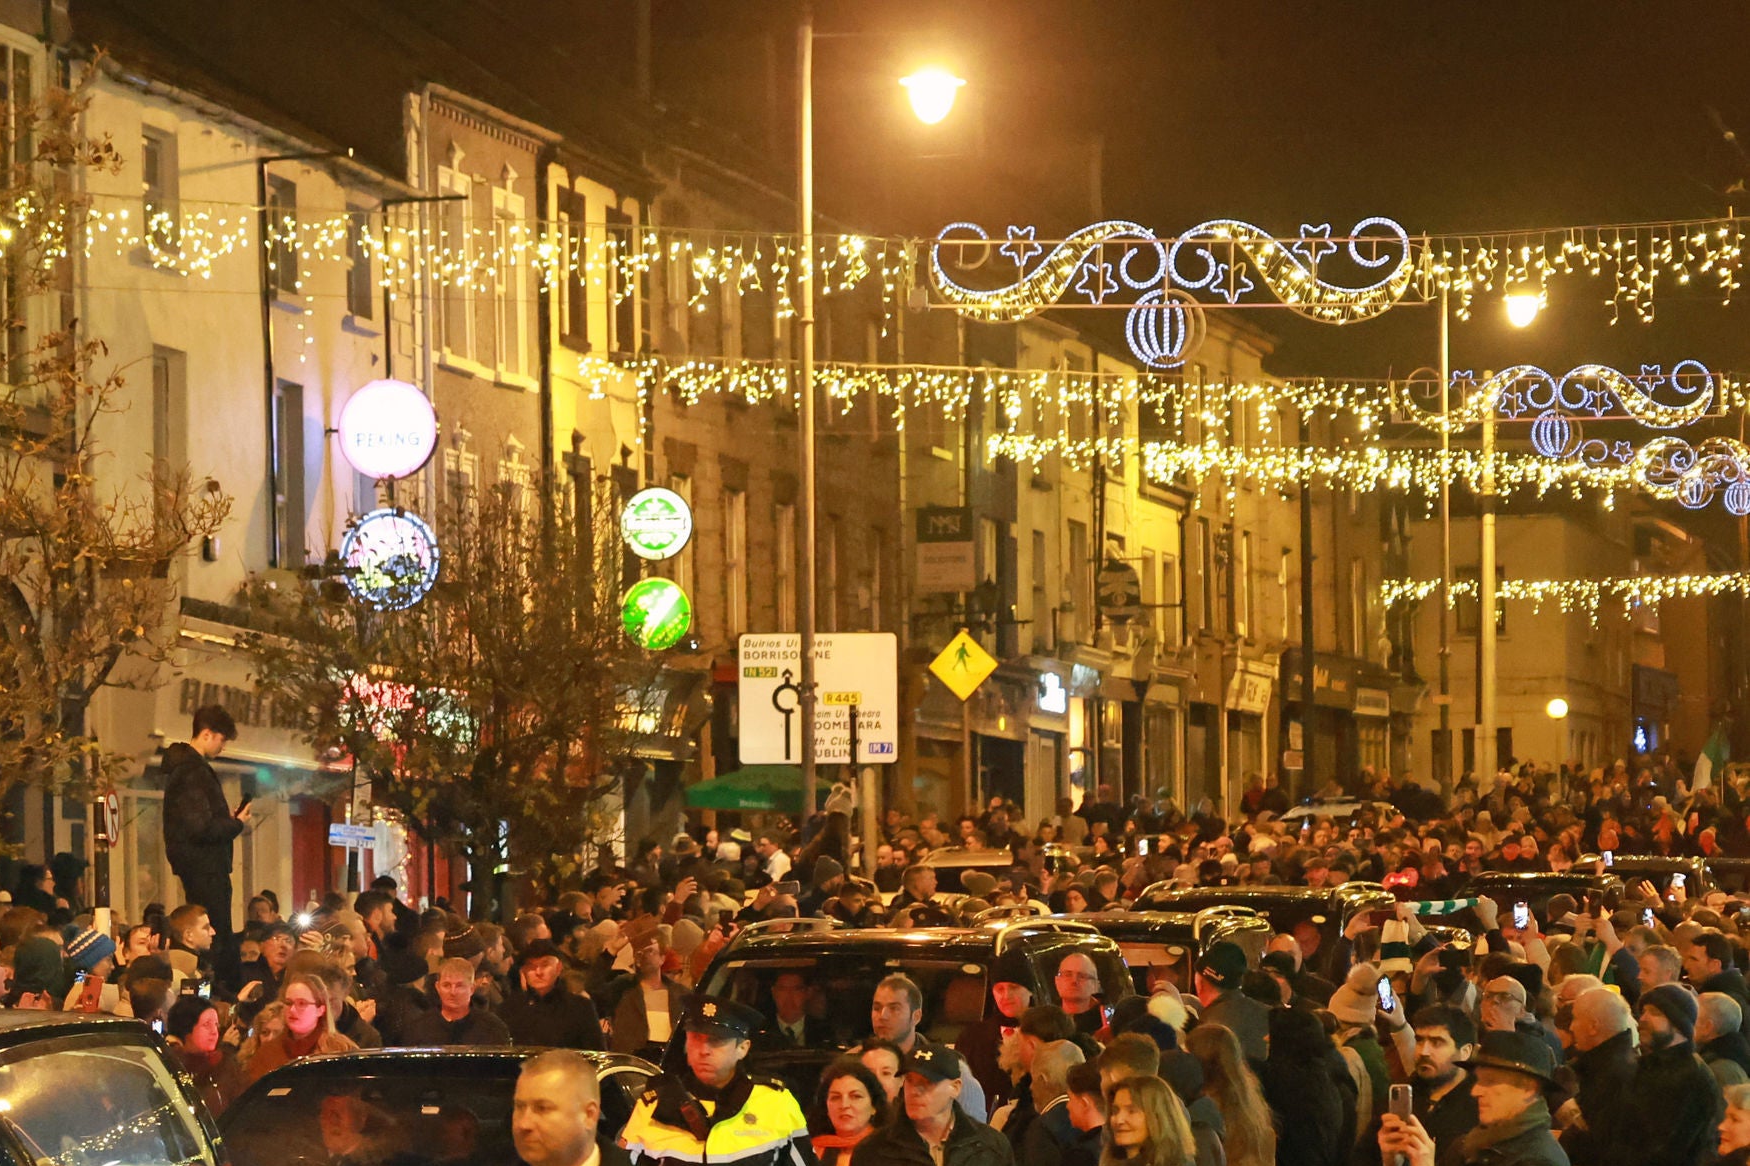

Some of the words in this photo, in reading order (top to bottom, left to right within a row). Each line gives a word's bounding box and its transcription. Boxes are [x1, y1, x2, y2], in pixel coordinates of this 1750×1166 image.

[356, 431, 420, 448] PEKING
[743, 650, 831, 660] BORRISONE
[835, 694, 858, 703] 445
[814, 721, 882, 730] OOMEARA
[815, 749, 851, 758] UBLIN
